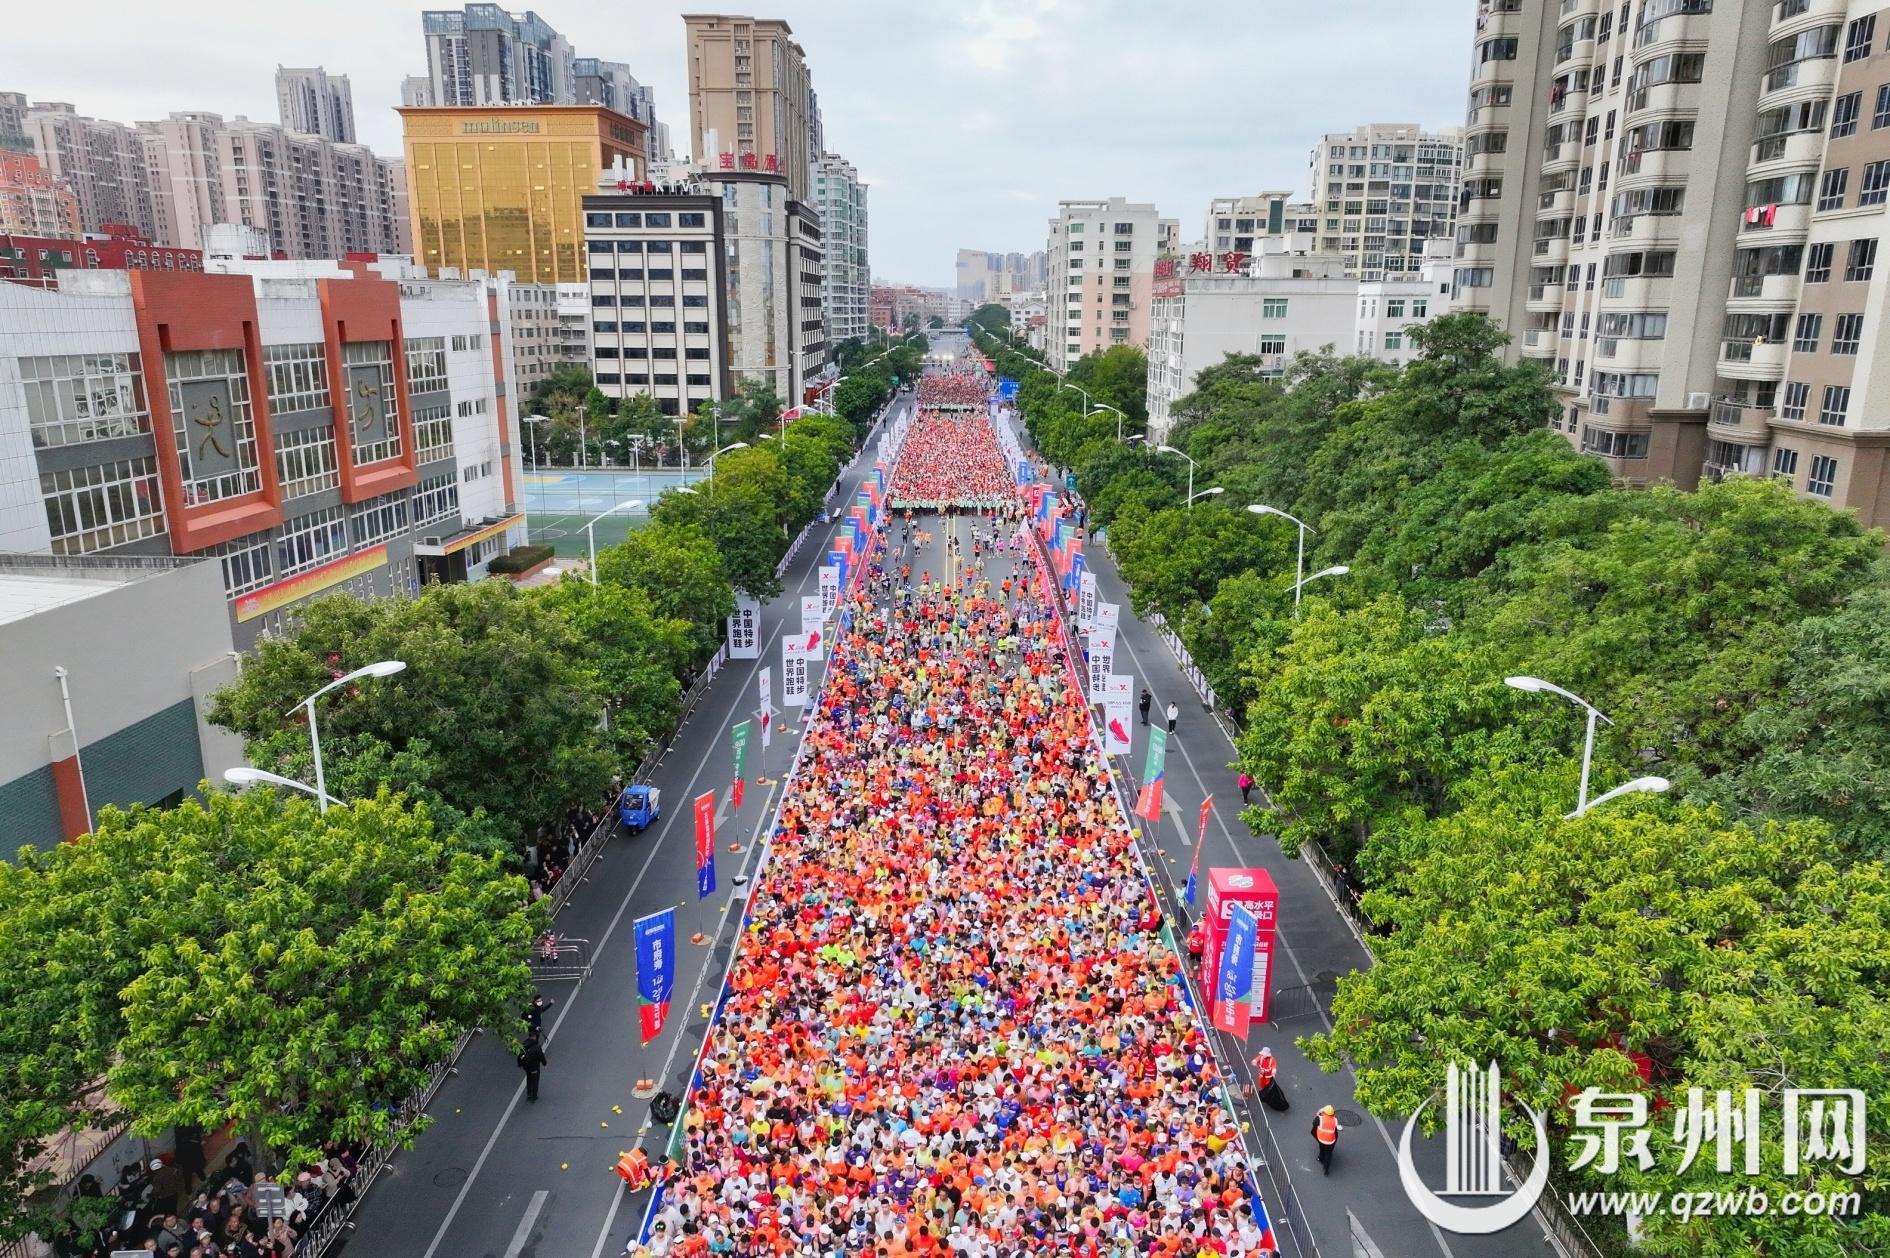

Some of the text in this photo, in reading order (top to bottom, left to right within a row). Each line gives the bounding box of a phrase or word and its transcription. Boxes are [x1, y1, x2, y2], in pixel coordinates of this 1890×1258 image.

[732, 609, 742, 648] 世界跑鞋
[743, 609, 753, 648] 中国特步
[786, 658, 794, 695] 世界跑鞋
[796, 658, 805, 694] 中国特步
